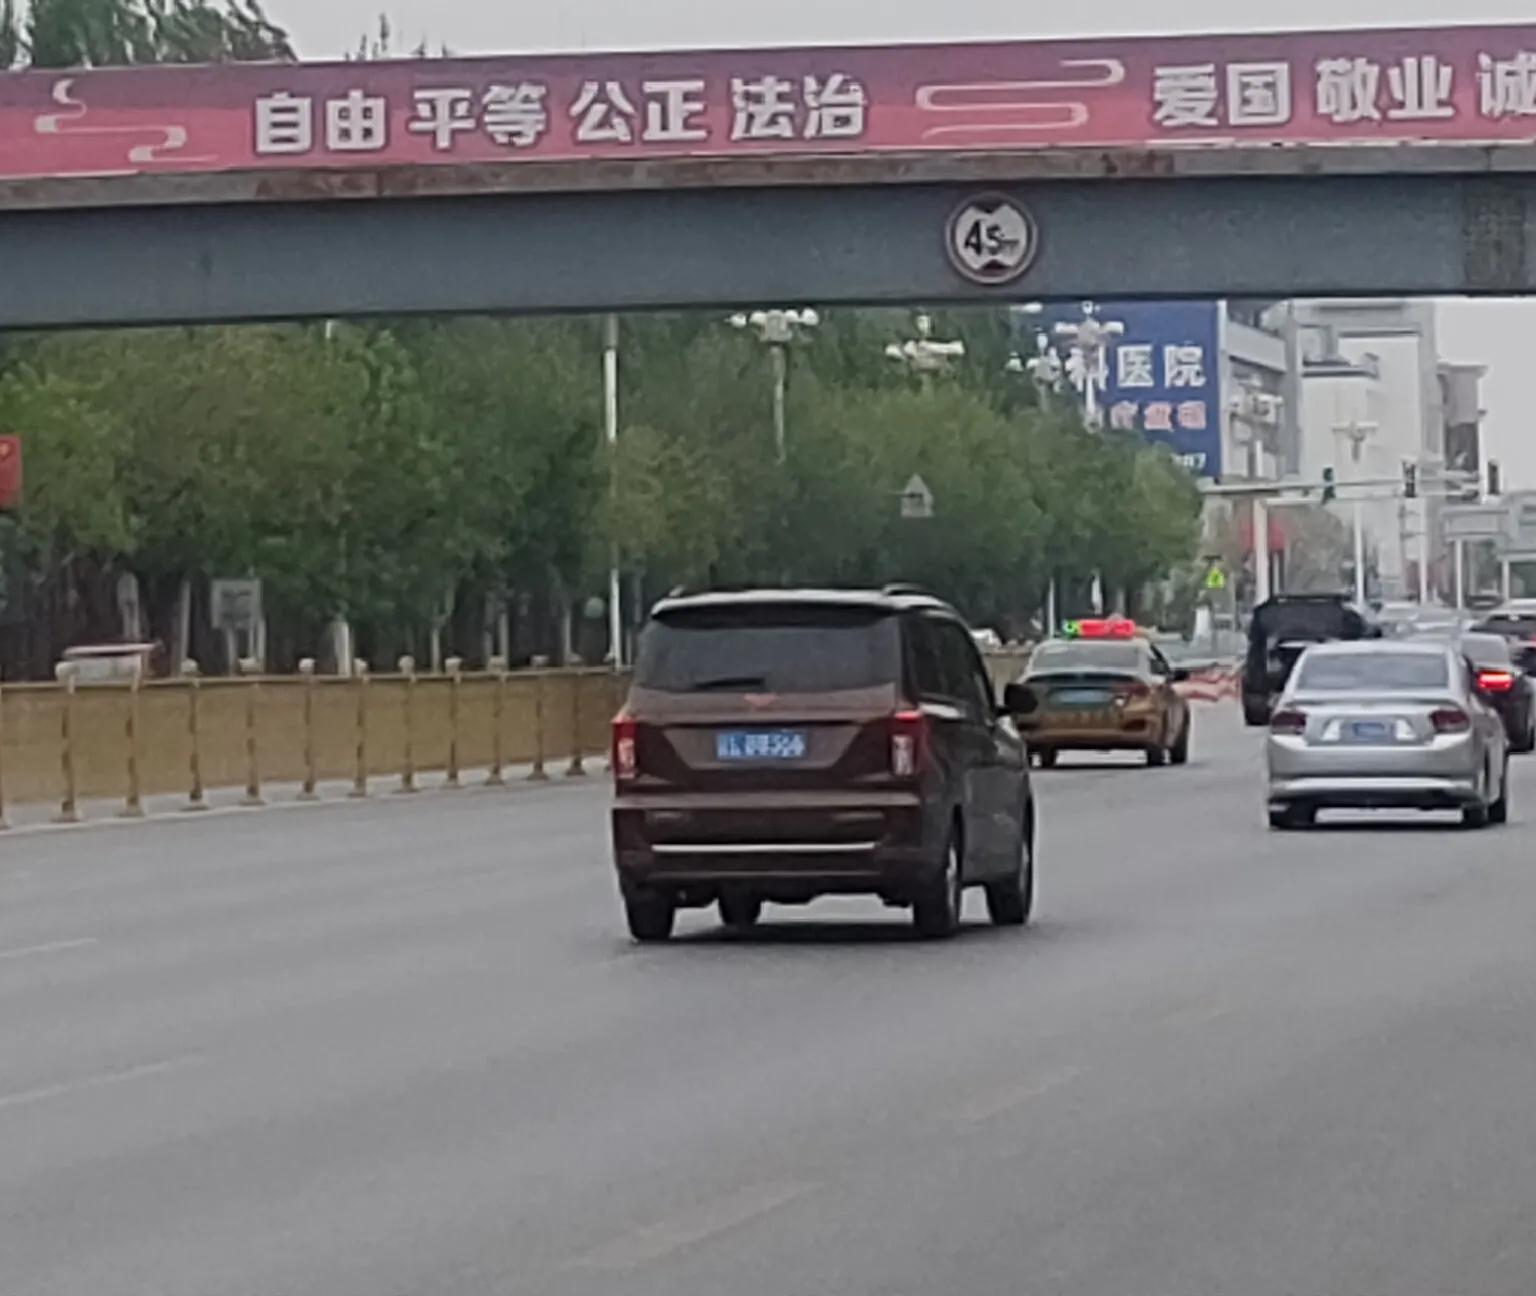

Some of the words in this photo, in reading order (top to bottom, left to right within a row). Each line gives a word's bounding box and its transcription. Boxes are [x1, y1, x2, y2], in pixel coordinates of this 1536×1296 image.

[254, 90, 386, 154] 自由
[408, 83, 547, 150] 平等
[569, 79, 709, 144] 公正
[728, 75, 868, 141] 法治
[1152, 60, 1291, 129] 爱国
[1314, 55, 1455, 123] 敬业
